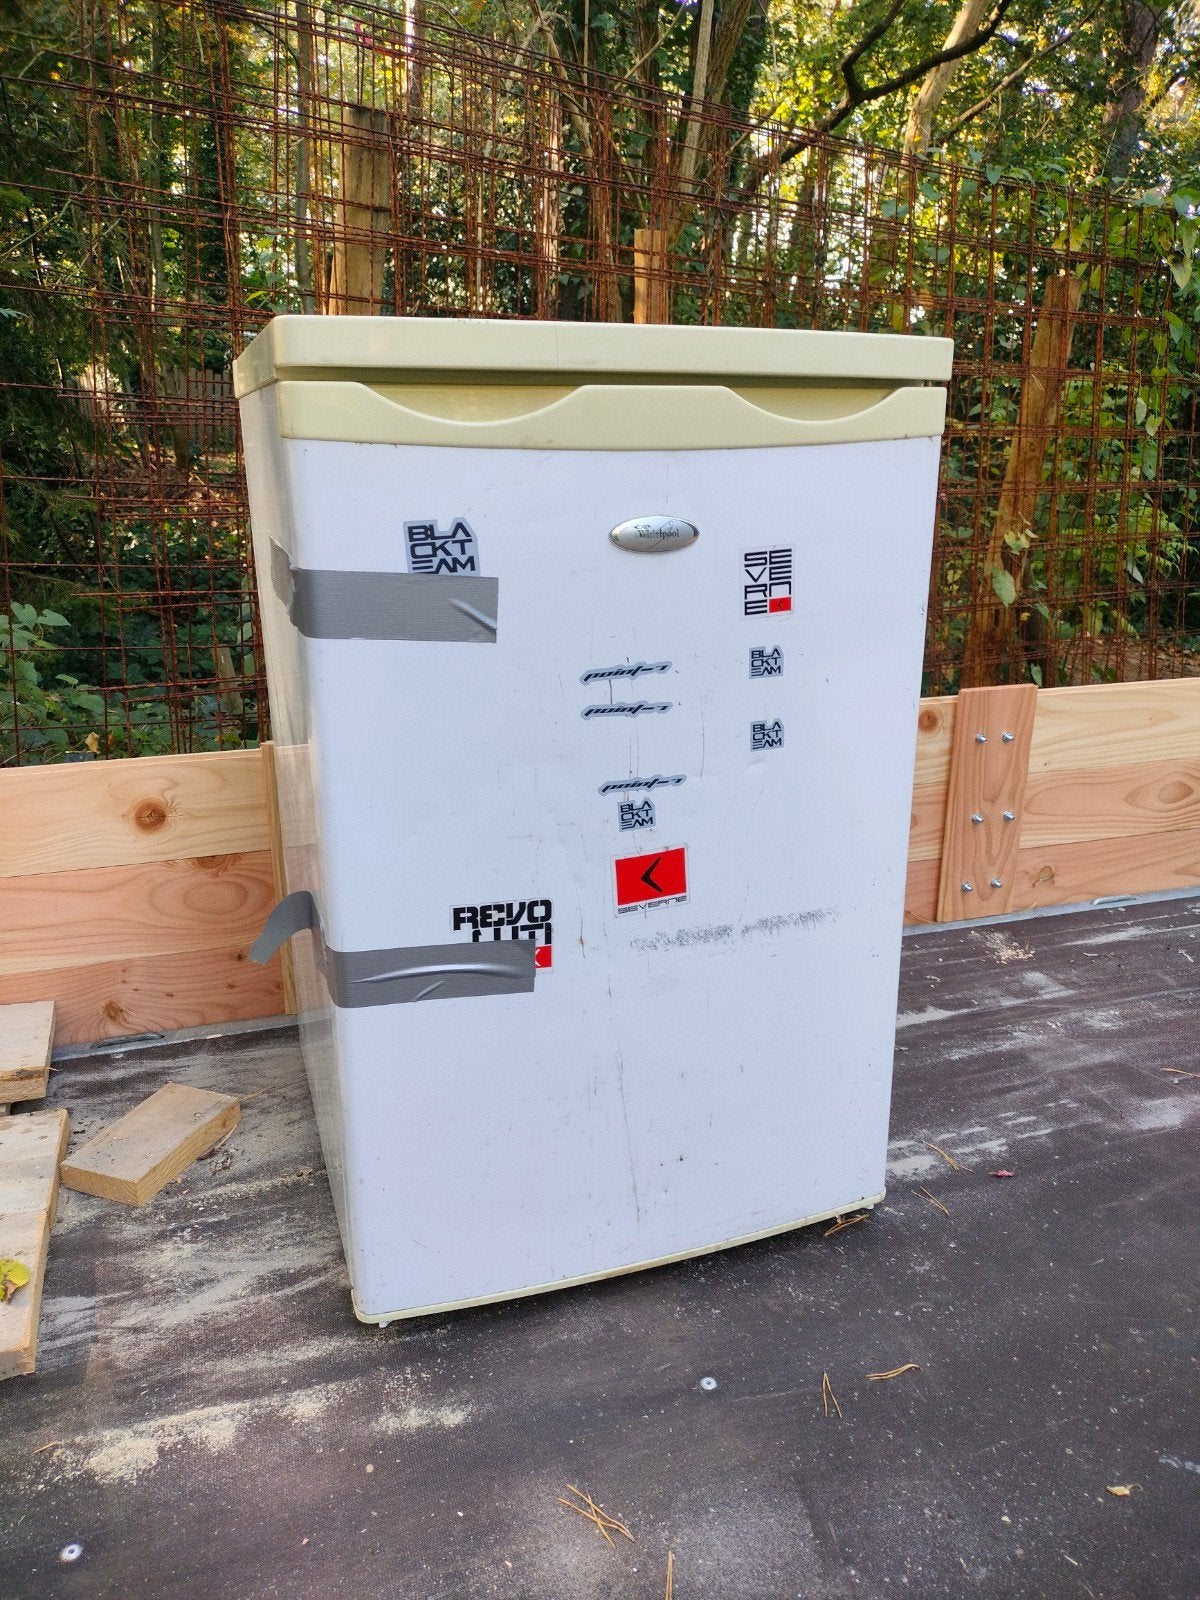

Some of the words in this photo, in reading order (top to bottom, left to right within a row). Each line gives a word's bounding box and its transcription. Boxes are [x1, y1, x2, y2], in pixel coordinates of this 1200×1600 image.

[408, 522, 472, 542] BLA
[410, 538, 473, 559] CKT
[751, 648, 781, 659] BLA
[751, 656, 782, 668] CKT
[752, 729, 782, 741] CKT
[620, 801, 653, 813] BLA
[620, 808, 653, 821] CKT
[453, 899, 552, 931] REVO
